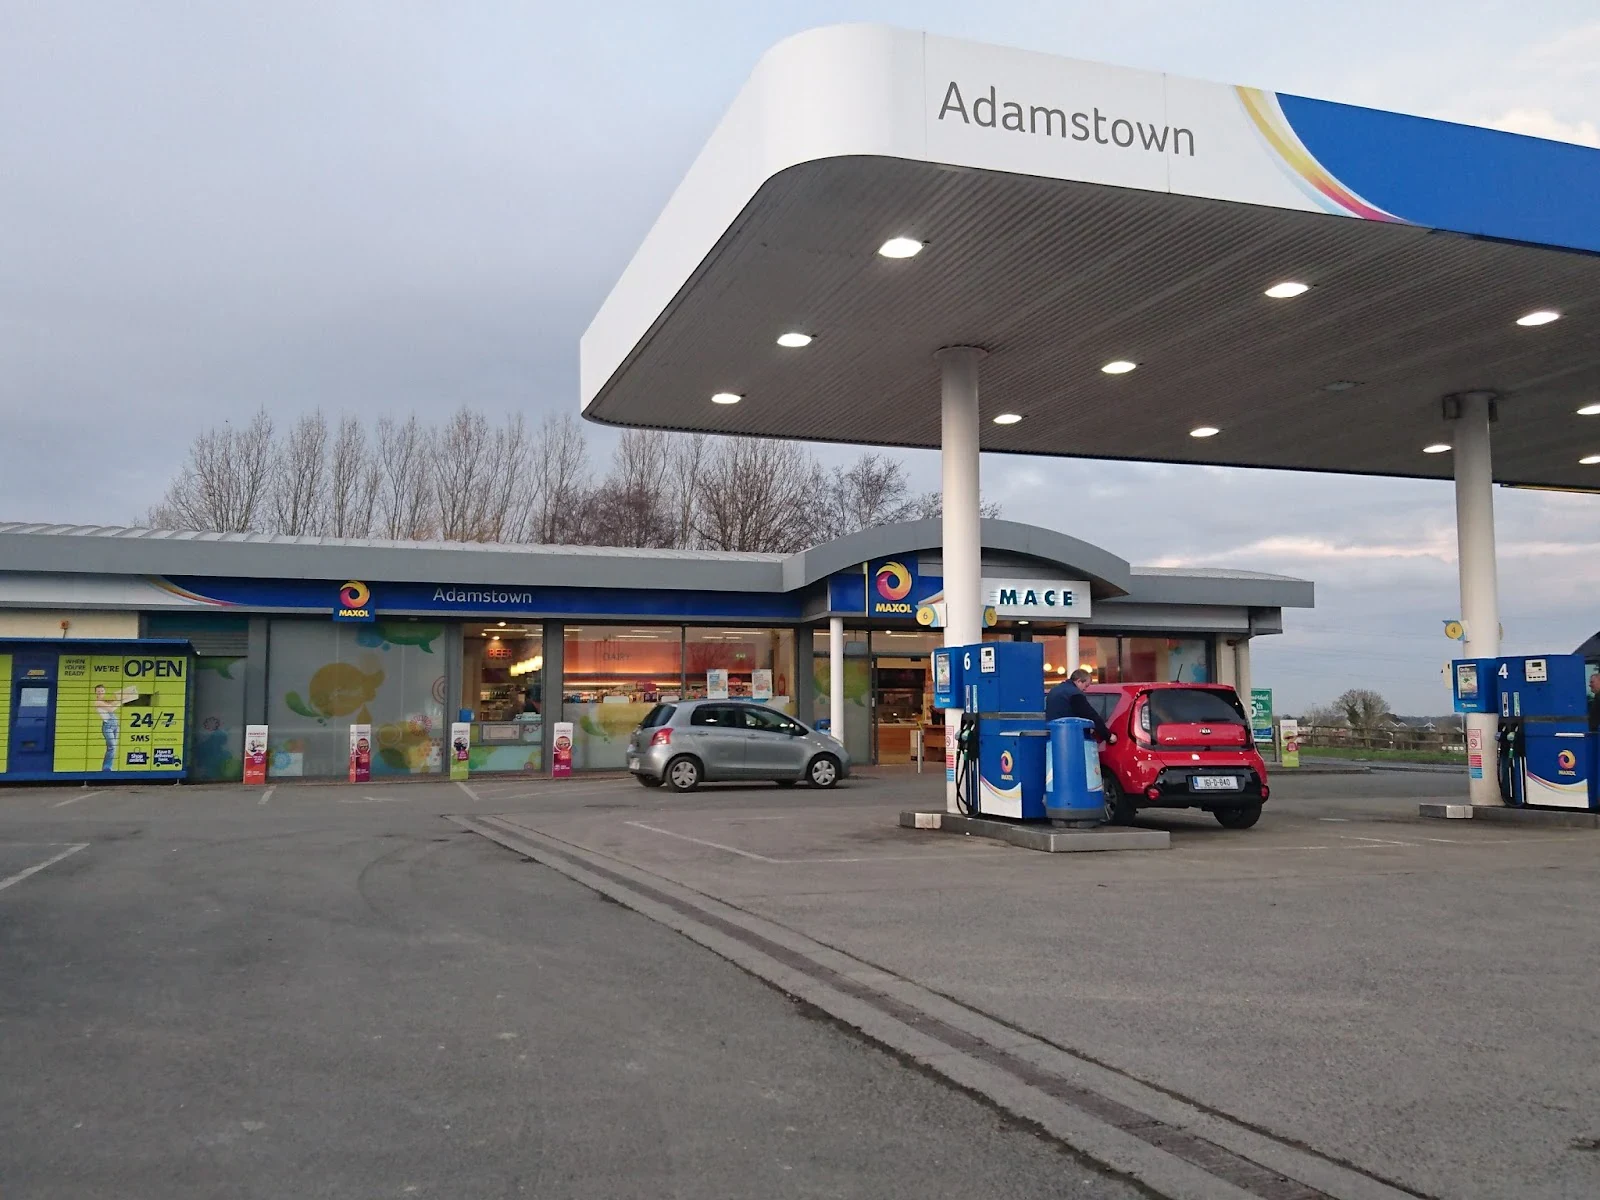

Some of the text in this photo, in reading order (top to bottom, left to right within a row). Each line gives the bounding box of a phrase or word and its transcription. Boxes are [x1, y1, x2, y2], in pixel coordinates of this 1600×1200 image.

[938, 81, 1194, 156] Adamstown
[433, 587, 533, 604] Adamstown
[999, 589, 1073, 606] MACE
[339, 609, 370, 618] MAXOL
[875, 603, 912, 614] MAXOL
[922, 612, 928, 620] 6
[488, 648, 512, 658] BEER
[93, 665, 120, 673] WE'RE
[124, 659, 183, 678] OPEN
[963, 652, 971, 671] 6
[1497, 663, 1509, 679] 4
[130, 711, 175, 730] 24/7
[130, 734, 150, 742] SMS
